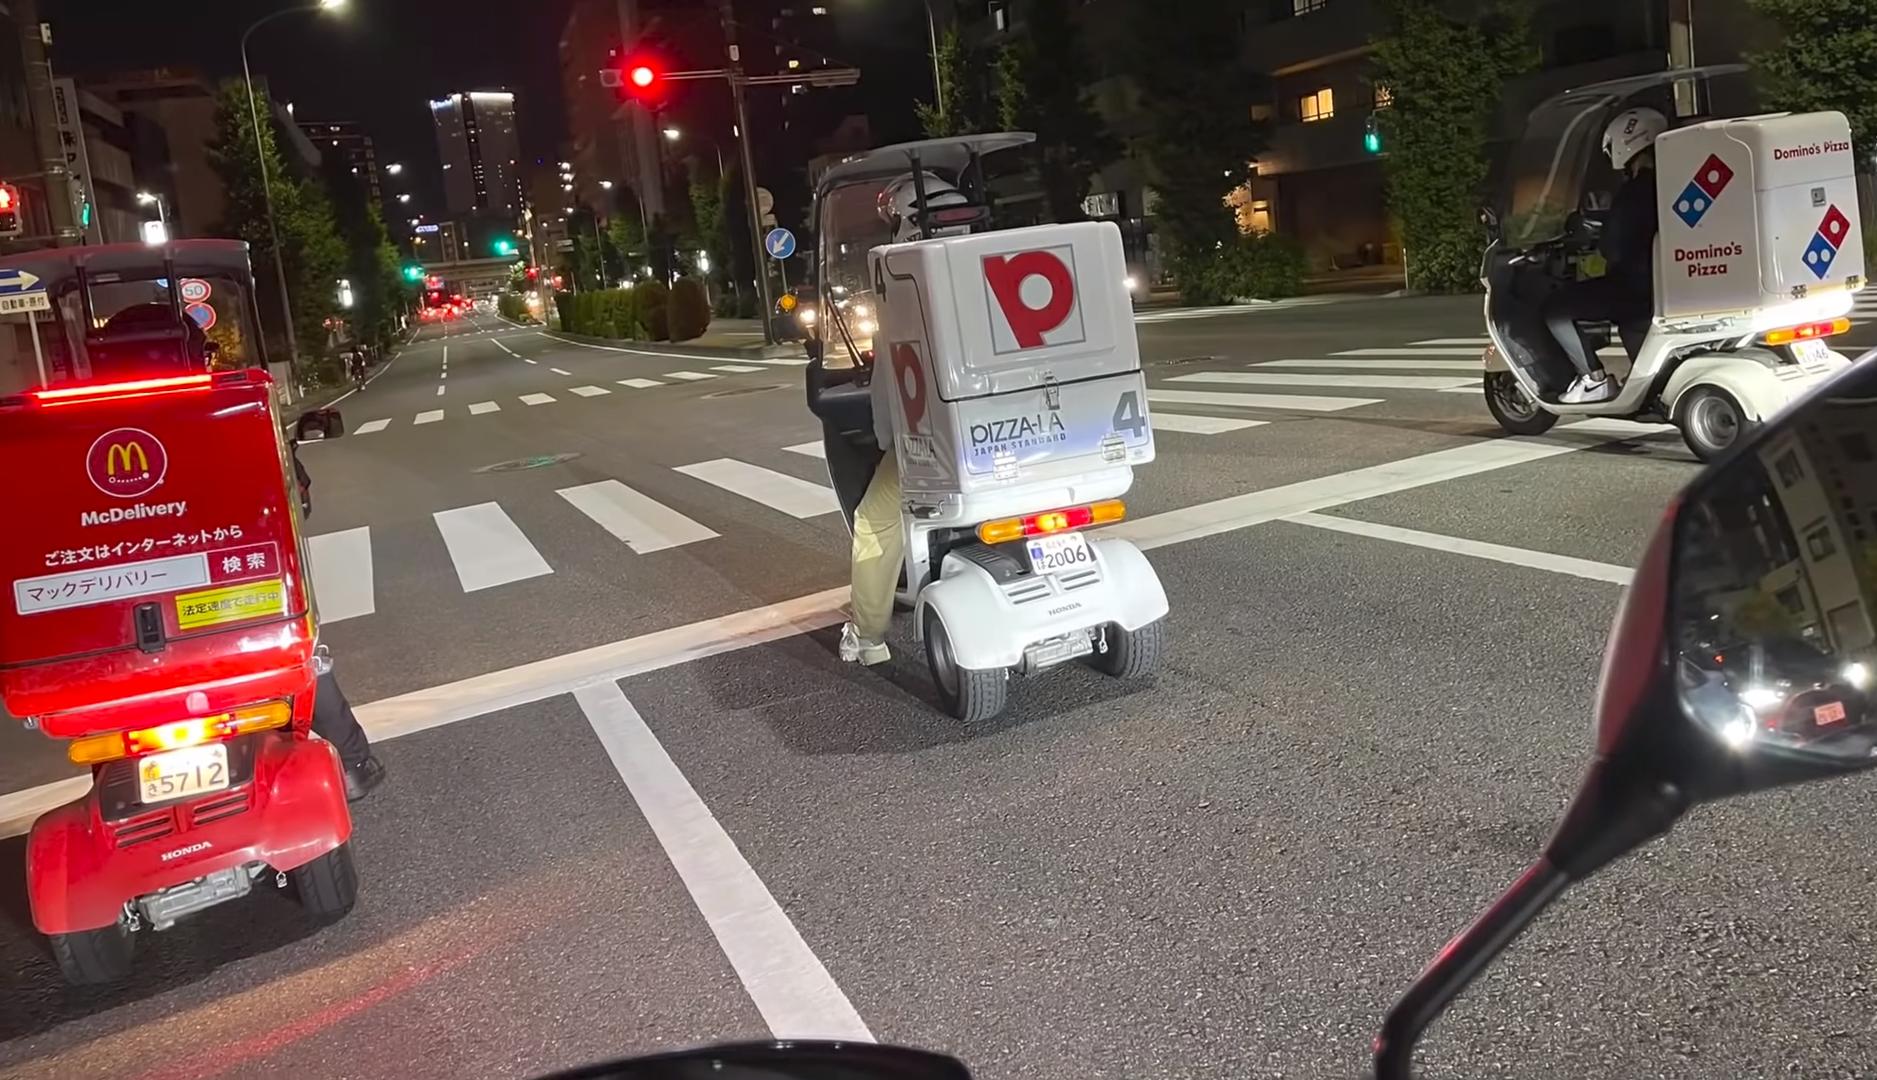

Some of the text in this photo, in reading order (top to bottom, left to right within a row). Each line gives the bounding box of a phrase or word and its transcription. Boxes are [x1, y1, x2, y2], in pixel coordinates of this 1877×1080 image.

[1774, 141, 1849, 160] Domino's Pizza
[1674, 241, 1742, 262] Domino's
[1688, 263, 1727, 277] Pizza
[184, 285, 203, 296] 50
[1113, 390, 1146, 438] 4
[974, 433, 1066, 457] JAPAN STANDARD
[81, 501, 186, 526] McDelivery
[45, 525, 243, 567] ご注文はインターネットから
[1045, 545, 1087, 569] 2006
[222, 552, 266, 574] 検索
[28, 569, 167, 602] マックデリバリー
[1048, 602, 1082, 616] HONDA
[160, 762, 225, 794] 5712
[161, 841, 213, 861] HONDA
